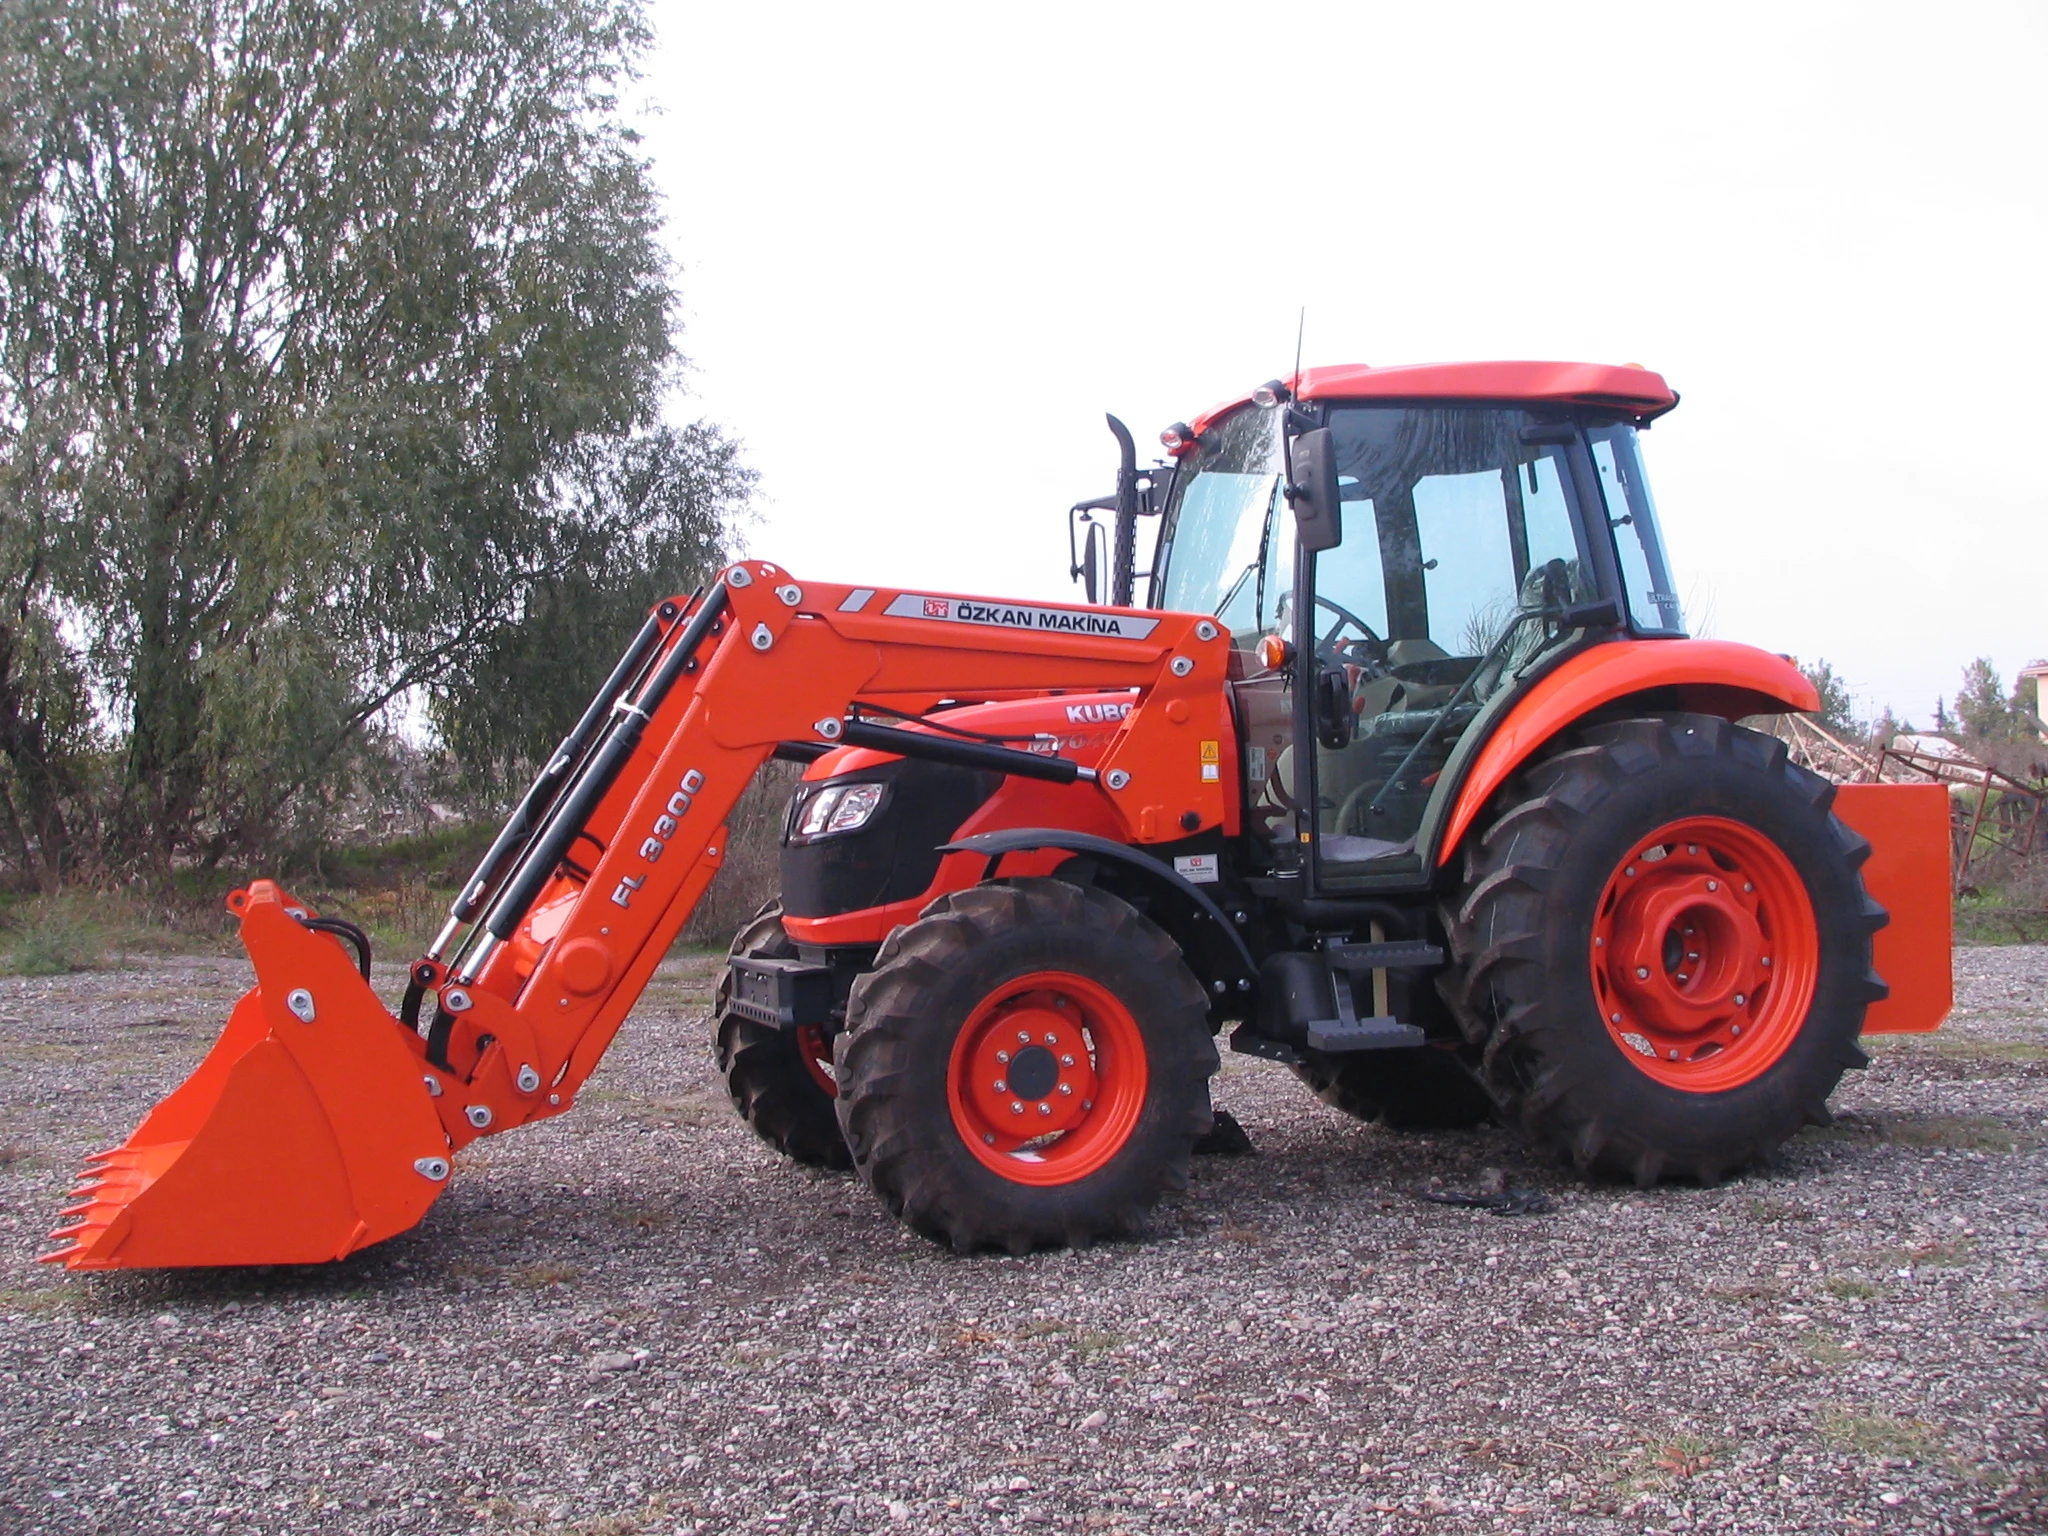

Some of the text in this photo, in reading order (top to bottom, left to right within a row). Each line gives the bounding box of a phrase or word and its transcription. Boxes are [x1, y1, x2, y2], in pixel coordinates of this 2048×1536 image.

[957, 603, 1121, 634] ÖZKAN MAKİNA
[611, 768, 705, 908] FL 3300
